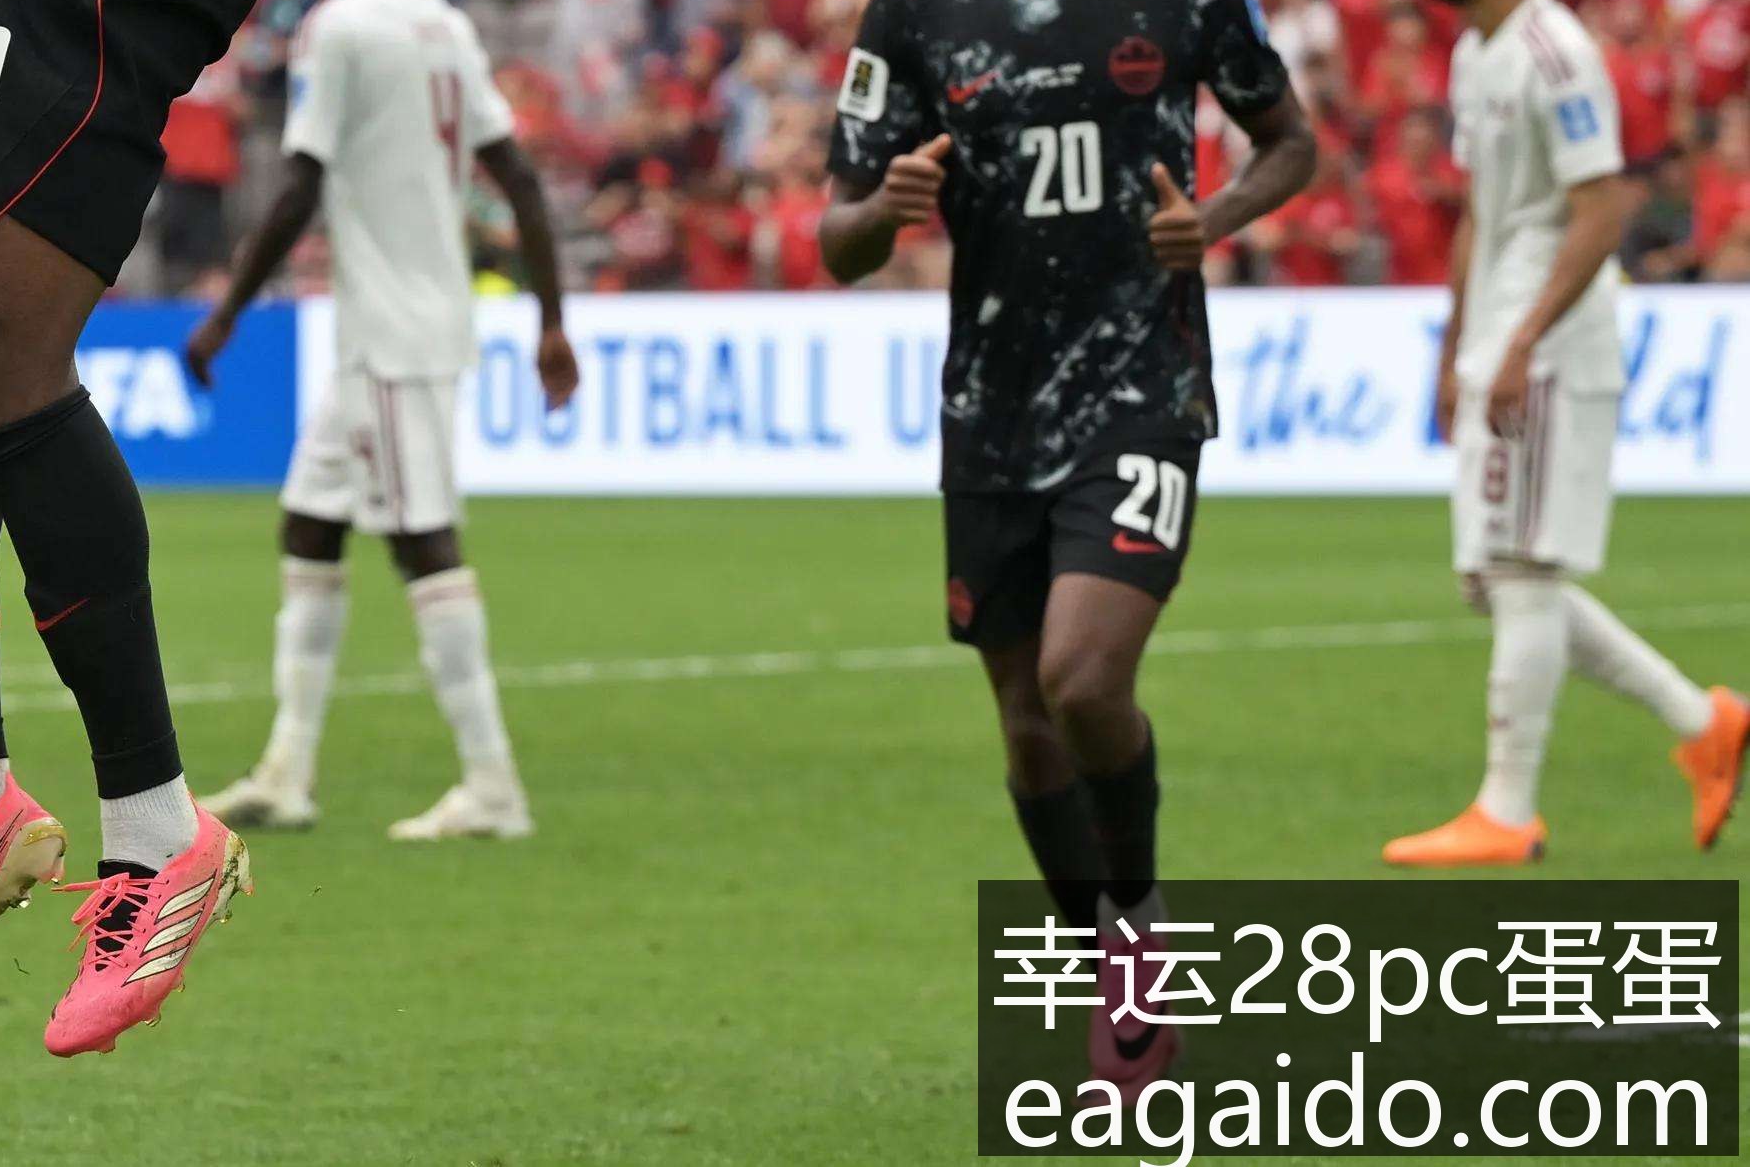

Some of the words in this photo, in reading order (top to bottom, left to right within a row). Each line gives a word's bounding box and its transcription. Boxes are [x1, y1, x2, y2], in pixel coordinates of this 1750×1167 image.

[1019, 120, 1102, 218] 20
[74, 346, 198, 438] FA
[477, 337, 847, 448] OTBALL
[1232, 313, 1393, 453] the
[1110, 453, 1188, 551] 20
